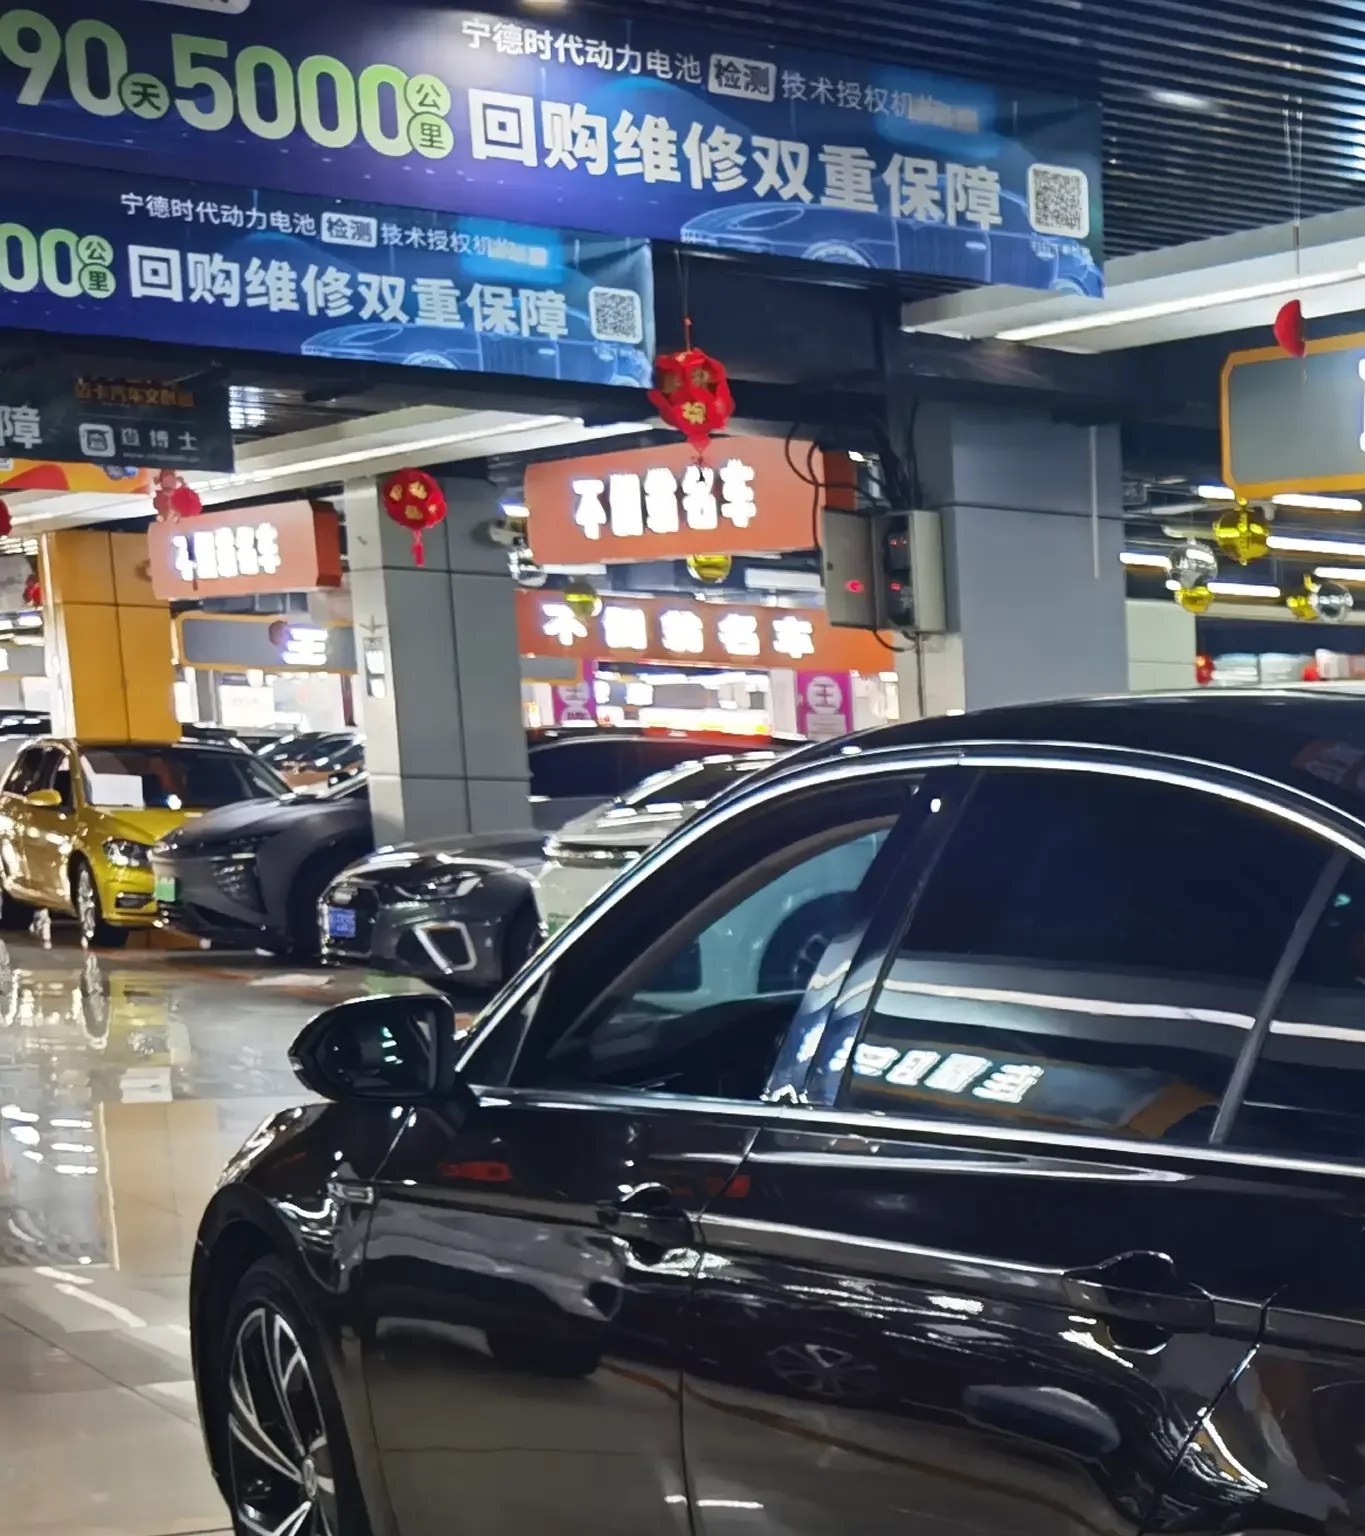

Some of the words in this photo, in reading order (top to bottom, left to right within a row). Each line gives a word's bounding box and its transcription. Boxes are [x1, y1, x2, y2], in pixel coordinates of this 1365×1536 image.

[461, 18, 702, 84] 宁德时代动力电池
[711, 56, 773, 98] 检测
[468, 88, 1002, 231] 回购维修双重保障
[121, 192, 317, 236] 宁德时代动力电池
[326, 216, 374, 244] 检测
[128, 244, 569, 340] 回购维修双重保障
